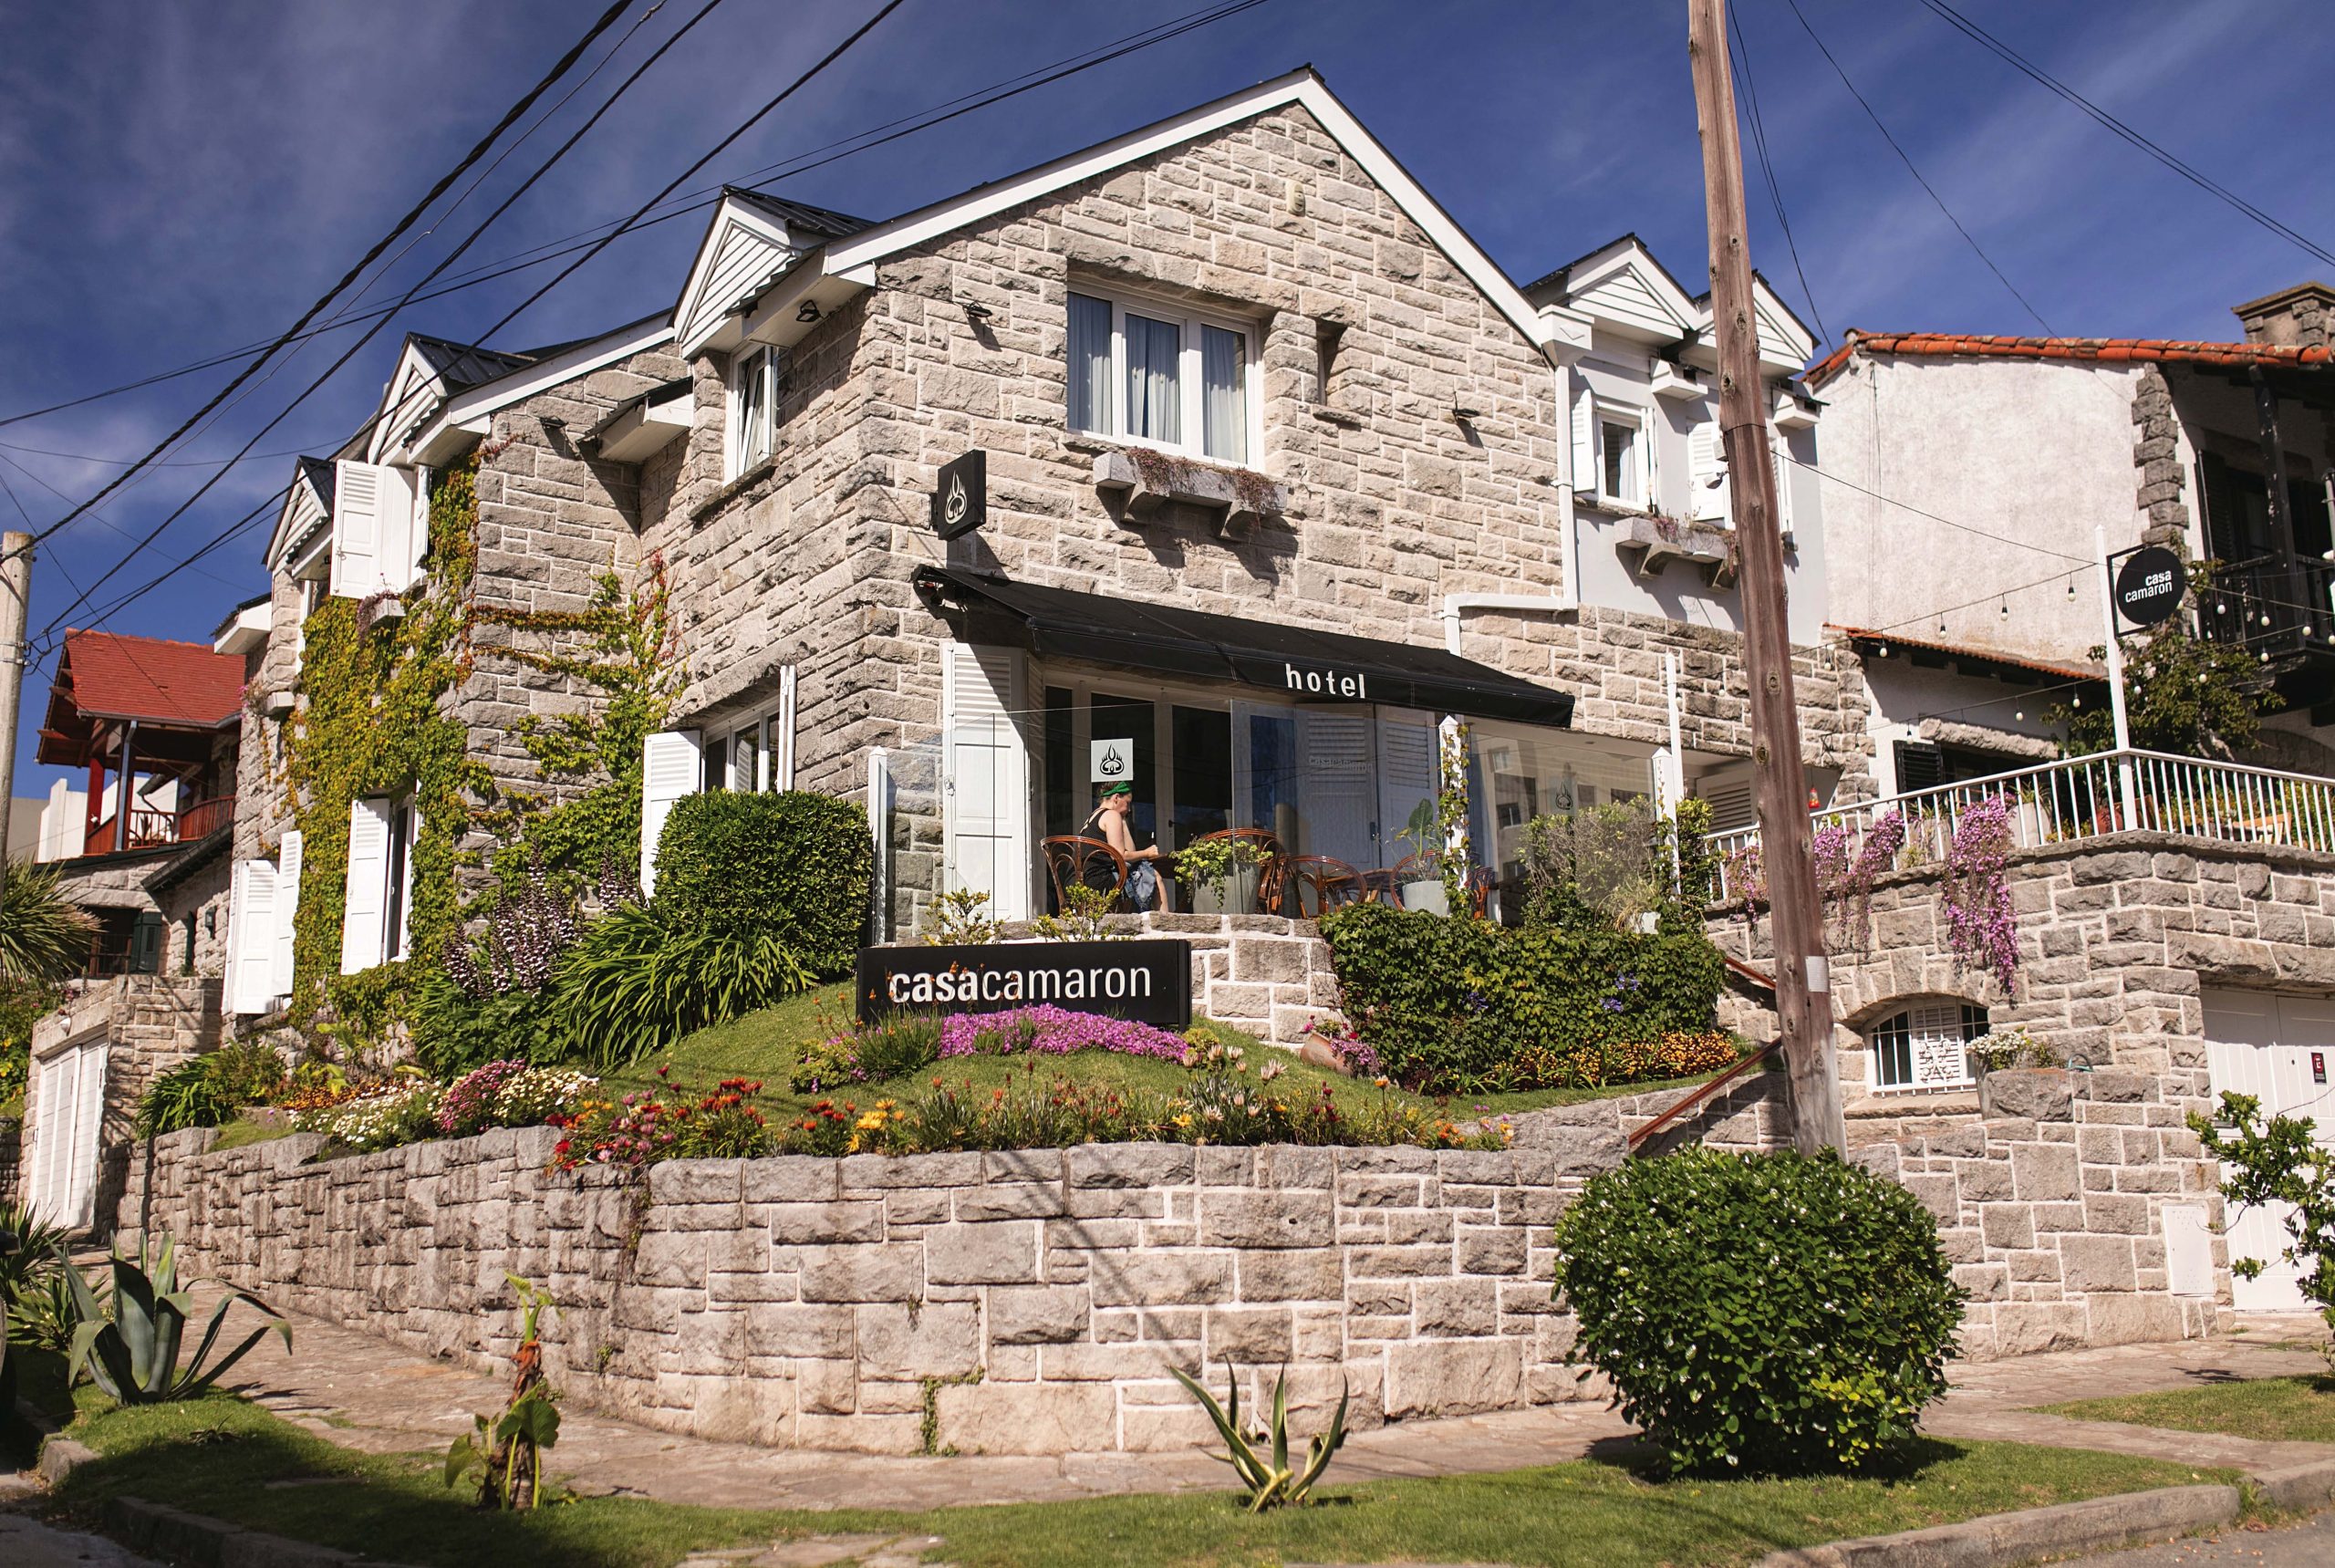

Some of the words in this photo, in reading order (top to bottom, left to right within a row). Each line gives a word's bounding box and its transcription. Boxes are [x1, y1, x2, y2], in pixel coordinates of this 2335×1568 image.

[2124, 581, 2173, 603] camaron
[2145, 570, 2172, 587] casa
[1285, 663, 1365, 699] hotel
[888, 967, 1150, 1002] casacamaron
